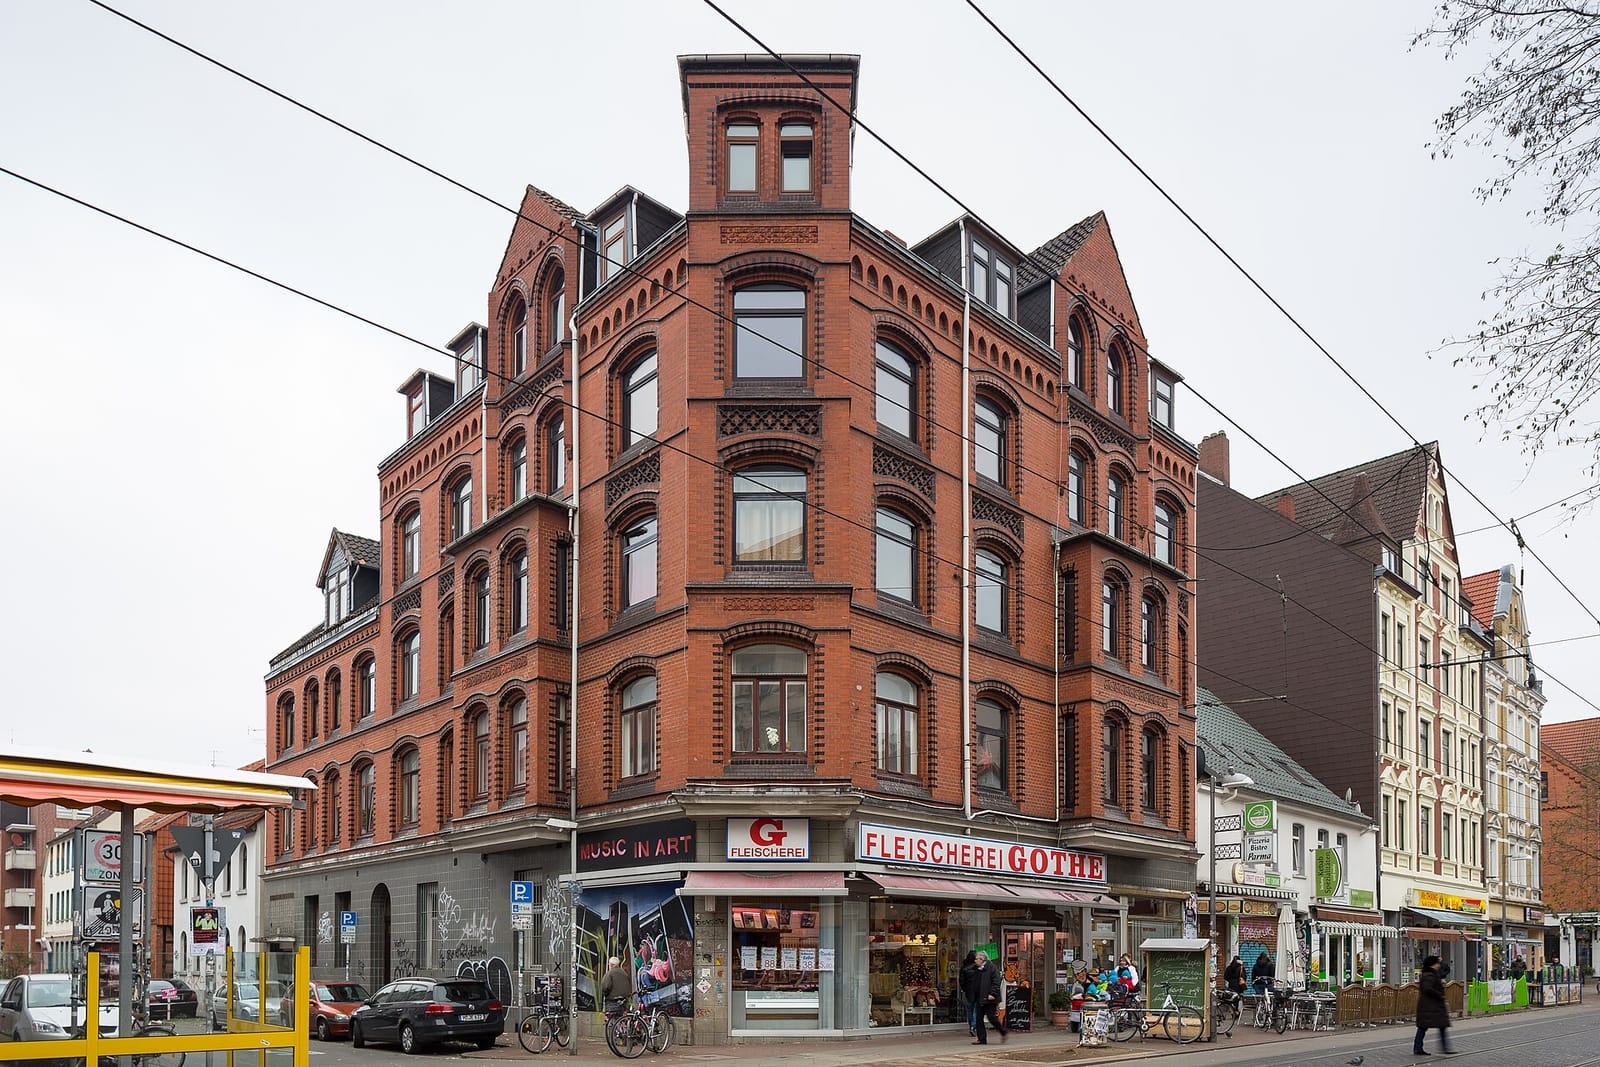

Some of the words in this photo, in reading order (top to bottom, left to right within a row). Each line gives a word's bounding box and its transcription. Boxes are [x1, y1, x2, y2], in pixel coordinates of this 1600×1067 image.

[749, 817, 788, 847] G
[1248, 837, 1270, 845] Pizzeria
[580, 839, 627, 860] MUSIC
[634, 840, 650, 858] IN
[655, 835, 692, 857] ART
[731, 847, 805, 858] FLEISCHEREI
[1250, 844, 1268, 852] Bistro
[865, 833, 1003, 870] FLEISCHEREI
[1008, 845, 1104, 880] GOTHE
[1247, 852, 1272, 861] Parma
[98, 870, 120, 880] ZON
